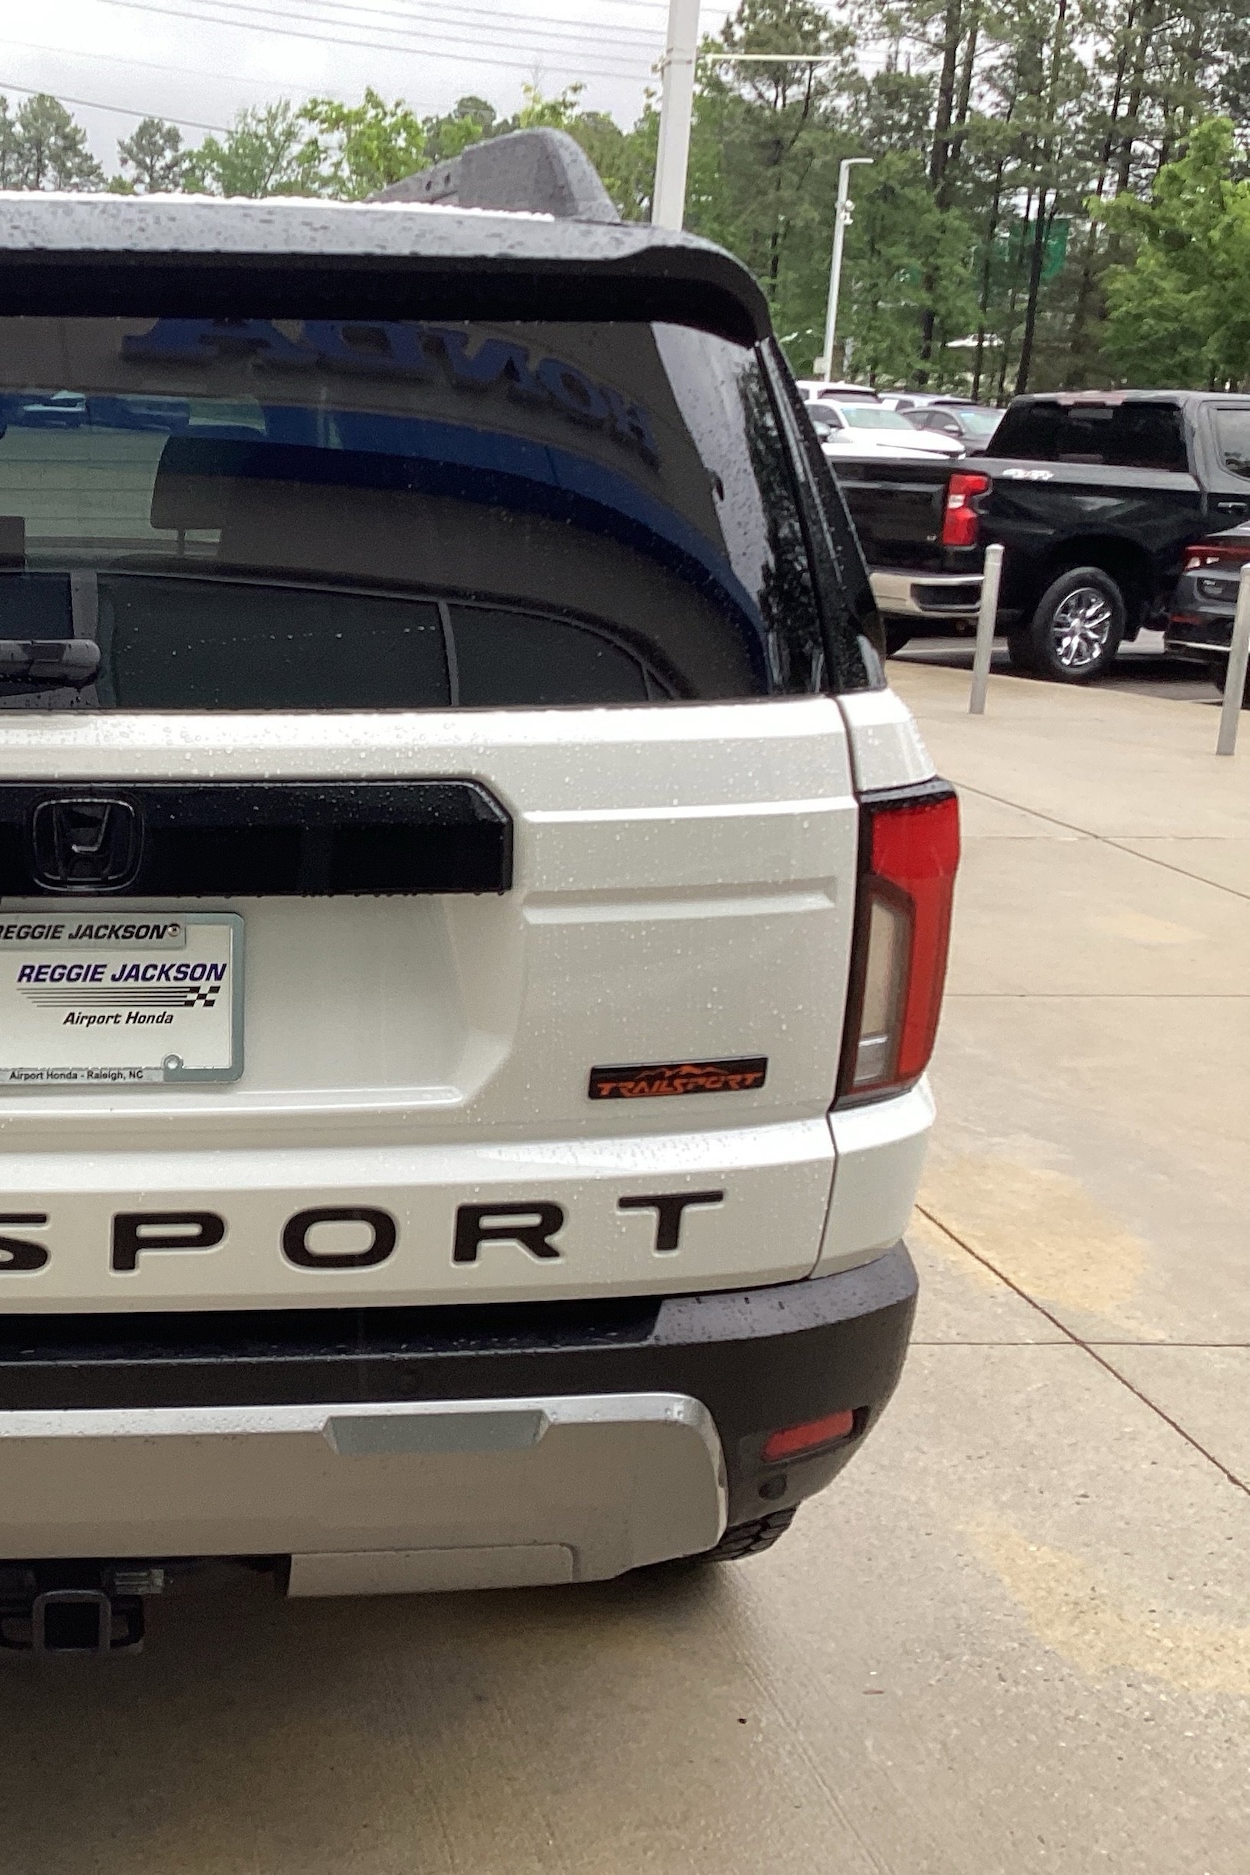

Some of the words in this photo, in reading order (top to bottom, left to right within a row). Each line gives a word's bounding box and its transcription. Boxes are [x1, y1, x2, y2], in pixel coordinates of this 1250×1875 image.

[68, 924, 168, 940] JACKSON
[16, 963, 107, 983] REGGIE
[110, 962, 228, 982] JACKSON
[62, 1011, 122, 1027] Airport
[125, 1011, 174, 1025] Honda
[9, 1070, 44, 1081] Airport
[46, 1070, 78, 1080] Honda
[86, 1070, 126, 1081] Raleigh,
[128, 1070, 144, 1079] NC
[597, 1071, 764, 1098] TRAILSPORT
